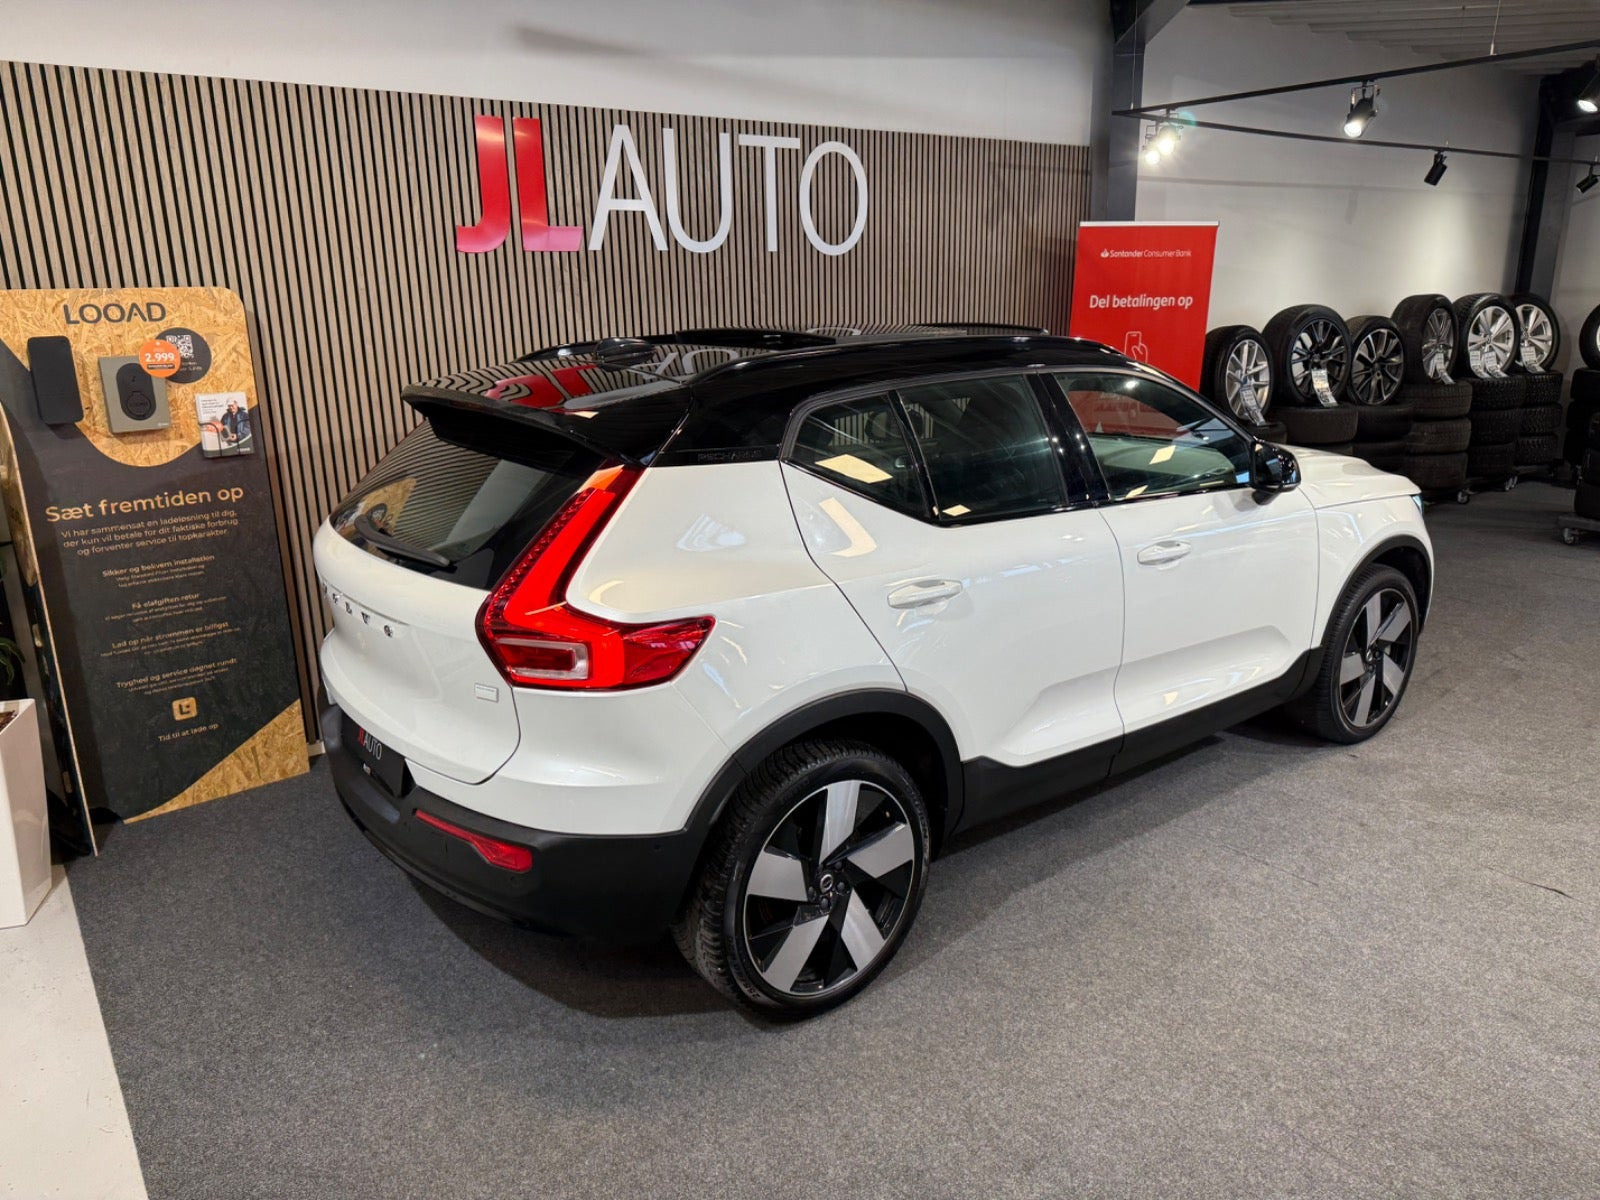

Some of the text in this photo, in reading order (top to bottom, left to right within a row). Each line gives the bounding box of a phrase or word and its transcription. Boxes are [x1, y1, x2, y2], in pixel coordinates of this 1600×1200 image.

[1110, 249, 1192, 258] Santander Consumer Bank
[63, 302, 166, 325] LOOAD
[1089, 293, 1194, 311] Del betalingen op
[145, 352, 175, 362] 2.999
[45, 486, 244, 523] Sæt fremtiden op
[61, 530, 71, 538] Vi
[73, 528, 89, 537] har
[91, 521, 145, 535] sammensat
[211, 510, 220, 518] til
[63, 540, 78, 548] der
[81, 537, 100, 546] kun
[102, 535, 112, 543] vil
[114, 531, 143, 541] betale
[144, 529, 156, 537] for
[159, 527, 171, 535] dit
[172, 522, 206, 533] faktiske
[77, 548, 90, 557] og
[92, 542, 133, 554] forventer
[136, 538, 167, 548] service
[168, 534, 177, 543] til
